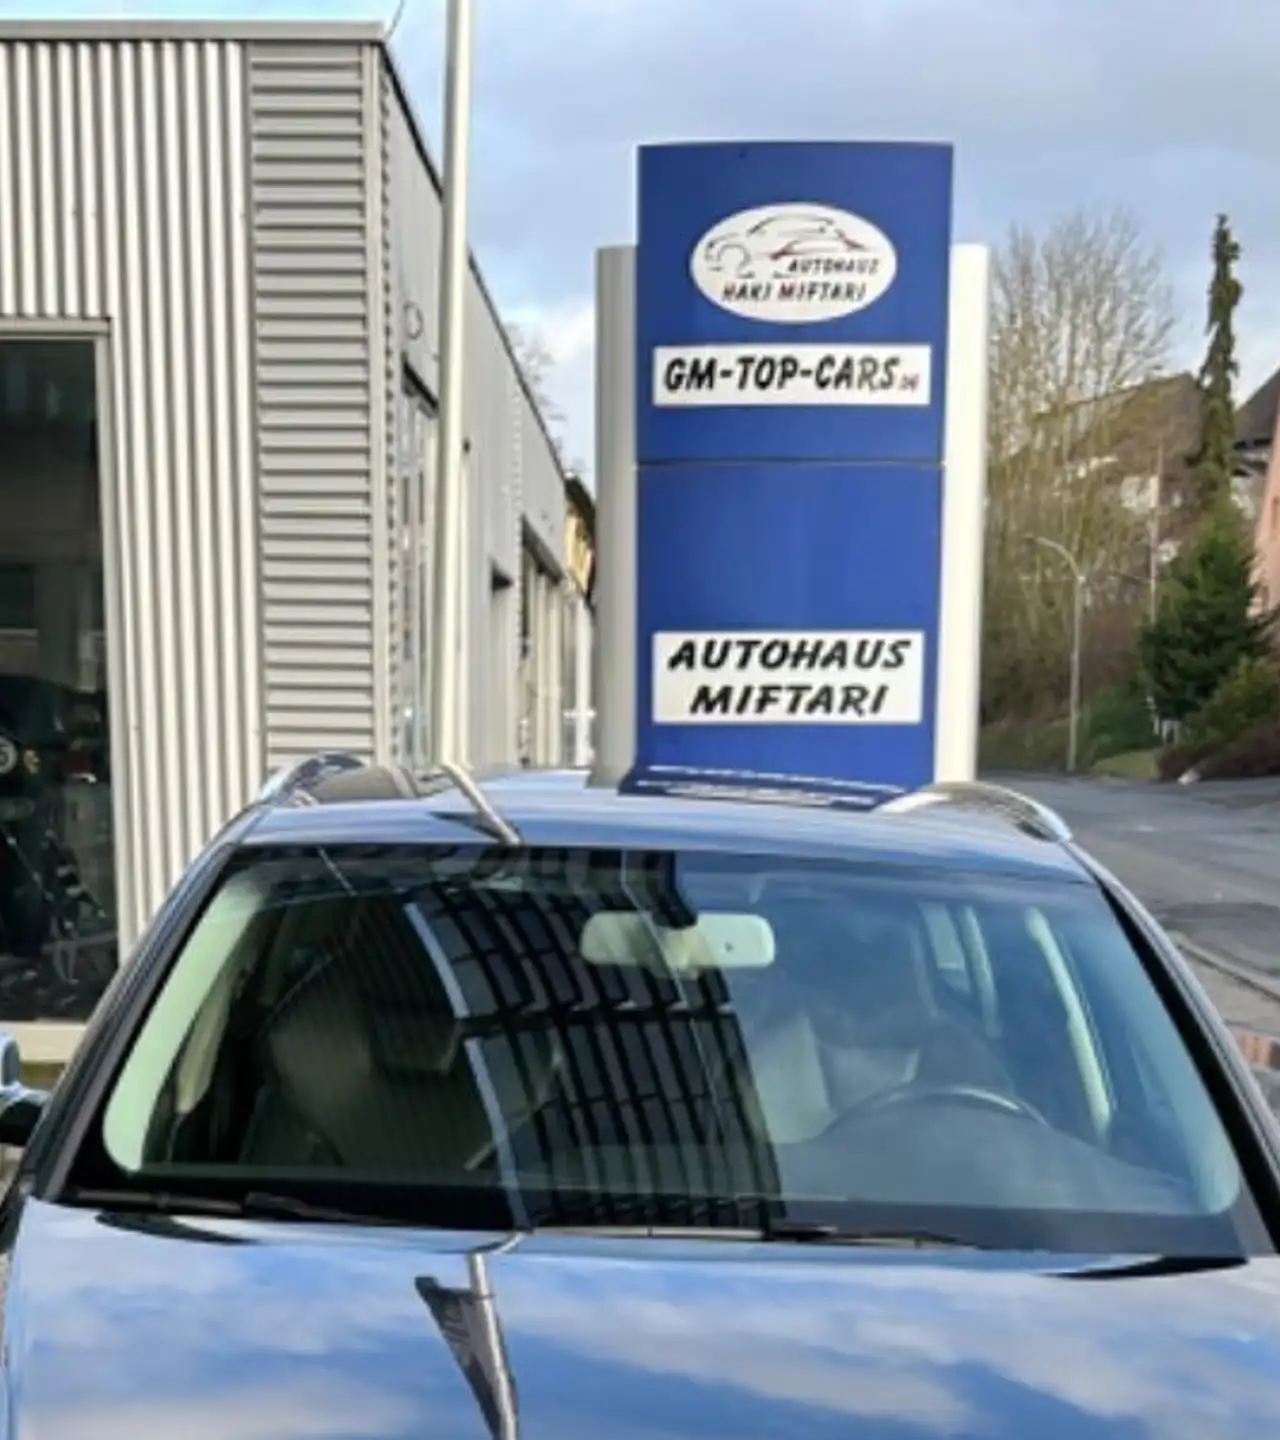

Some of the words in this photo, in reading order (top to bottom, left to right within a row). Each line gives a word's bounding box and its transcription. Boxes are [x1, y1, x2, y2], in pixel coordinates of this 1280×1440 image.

[788, 258, 880, 274] AUTOHAUS
[723, 282, 771, 300] HAKI
[778, 282, 867, 301] MIFTARI
[667, 639, 912, 671] AUTOHAUS
[689, 685, 889, 716] MIFTARI
